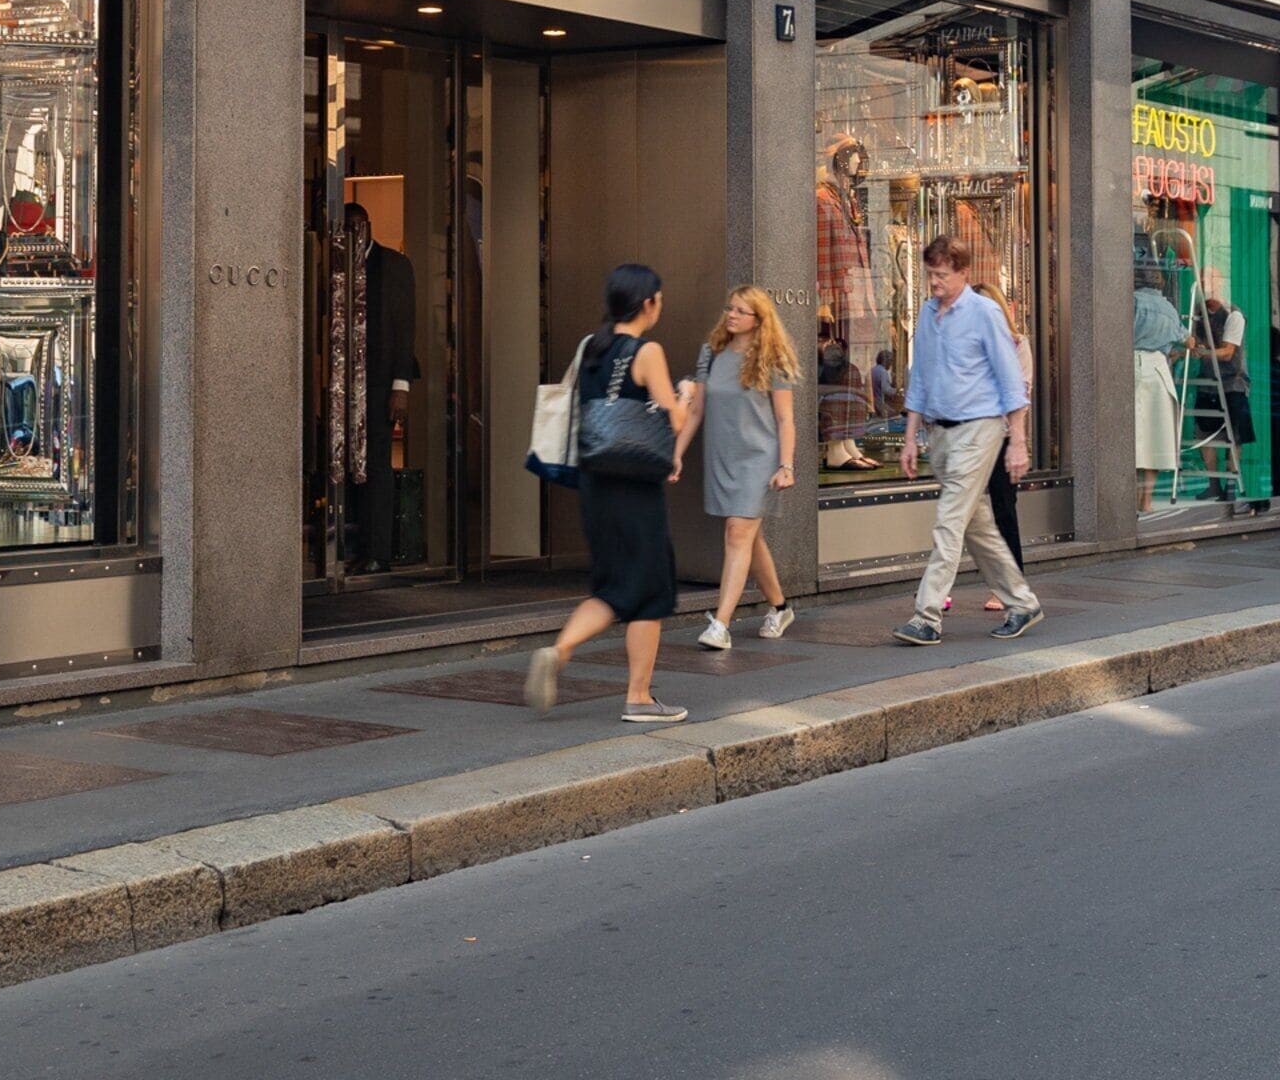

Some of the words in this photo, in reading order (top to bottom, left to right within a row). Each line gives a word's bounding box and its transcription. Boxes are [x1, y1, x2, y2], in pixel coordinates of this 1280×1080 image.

[1132, 103, 1216, 158] FAUSTO
[1133, 155, 1216, 205] PUGLISI
[208, 263, 290, 289] GUCCI
